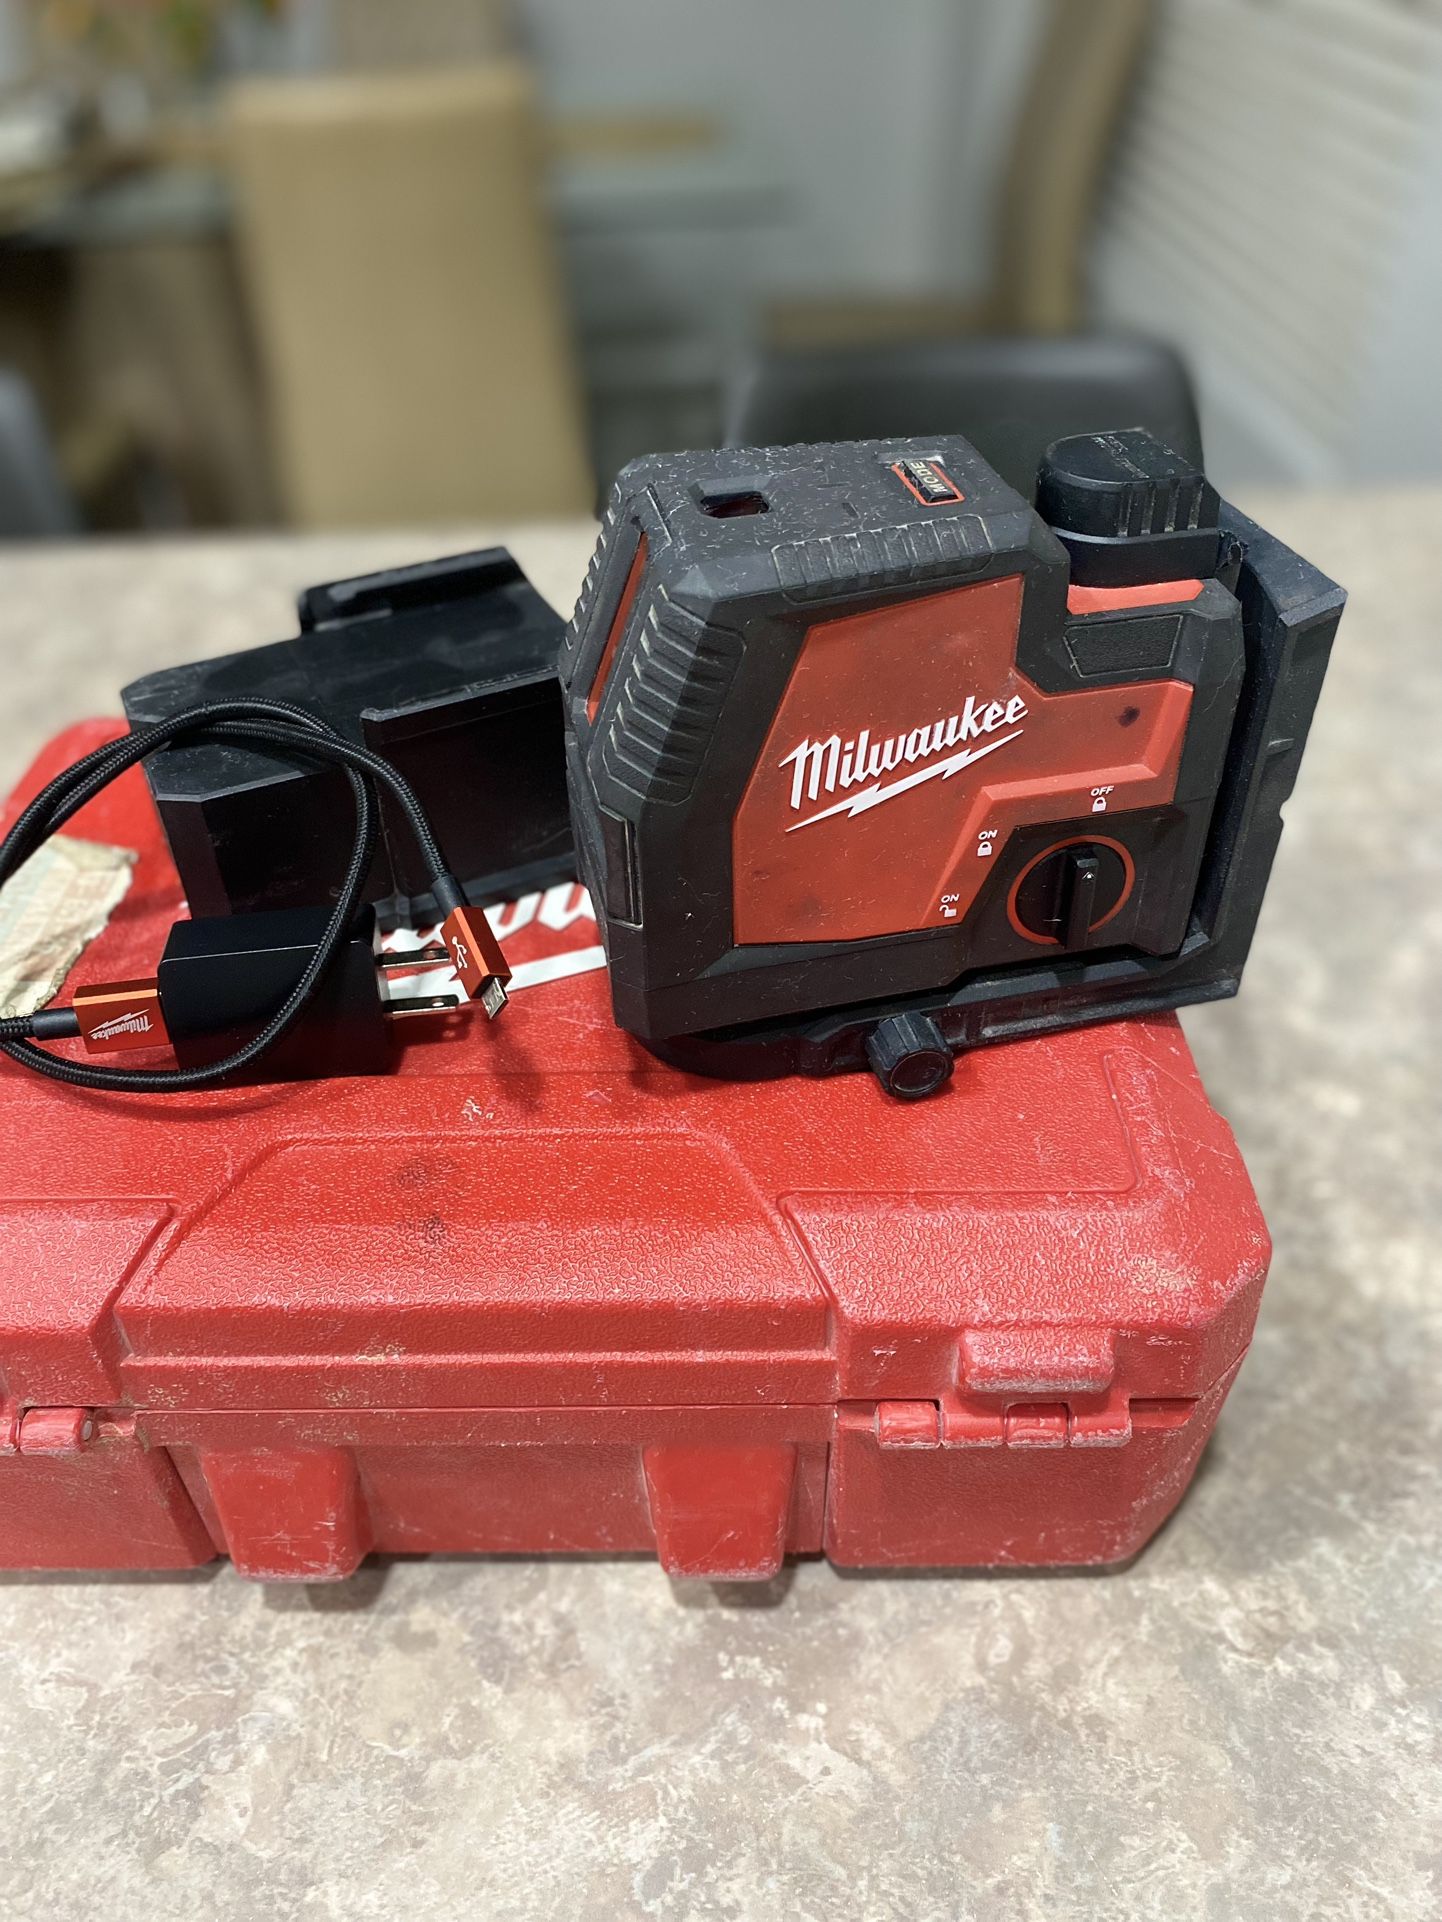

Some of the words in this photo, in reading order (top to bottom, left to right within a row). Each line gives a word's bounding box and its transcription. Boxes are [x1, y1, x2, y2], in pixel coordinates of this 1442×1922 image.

[910, 461, 948, 492] MODE
[778, 694, 1029, 810] Milwaukee
[1090, 785, 1115, 797] OFF
[978, 829, 998, 840] ON
[941, 893, 960, 904] ON
[90, 1015, 154, 1040] Milwaukee
